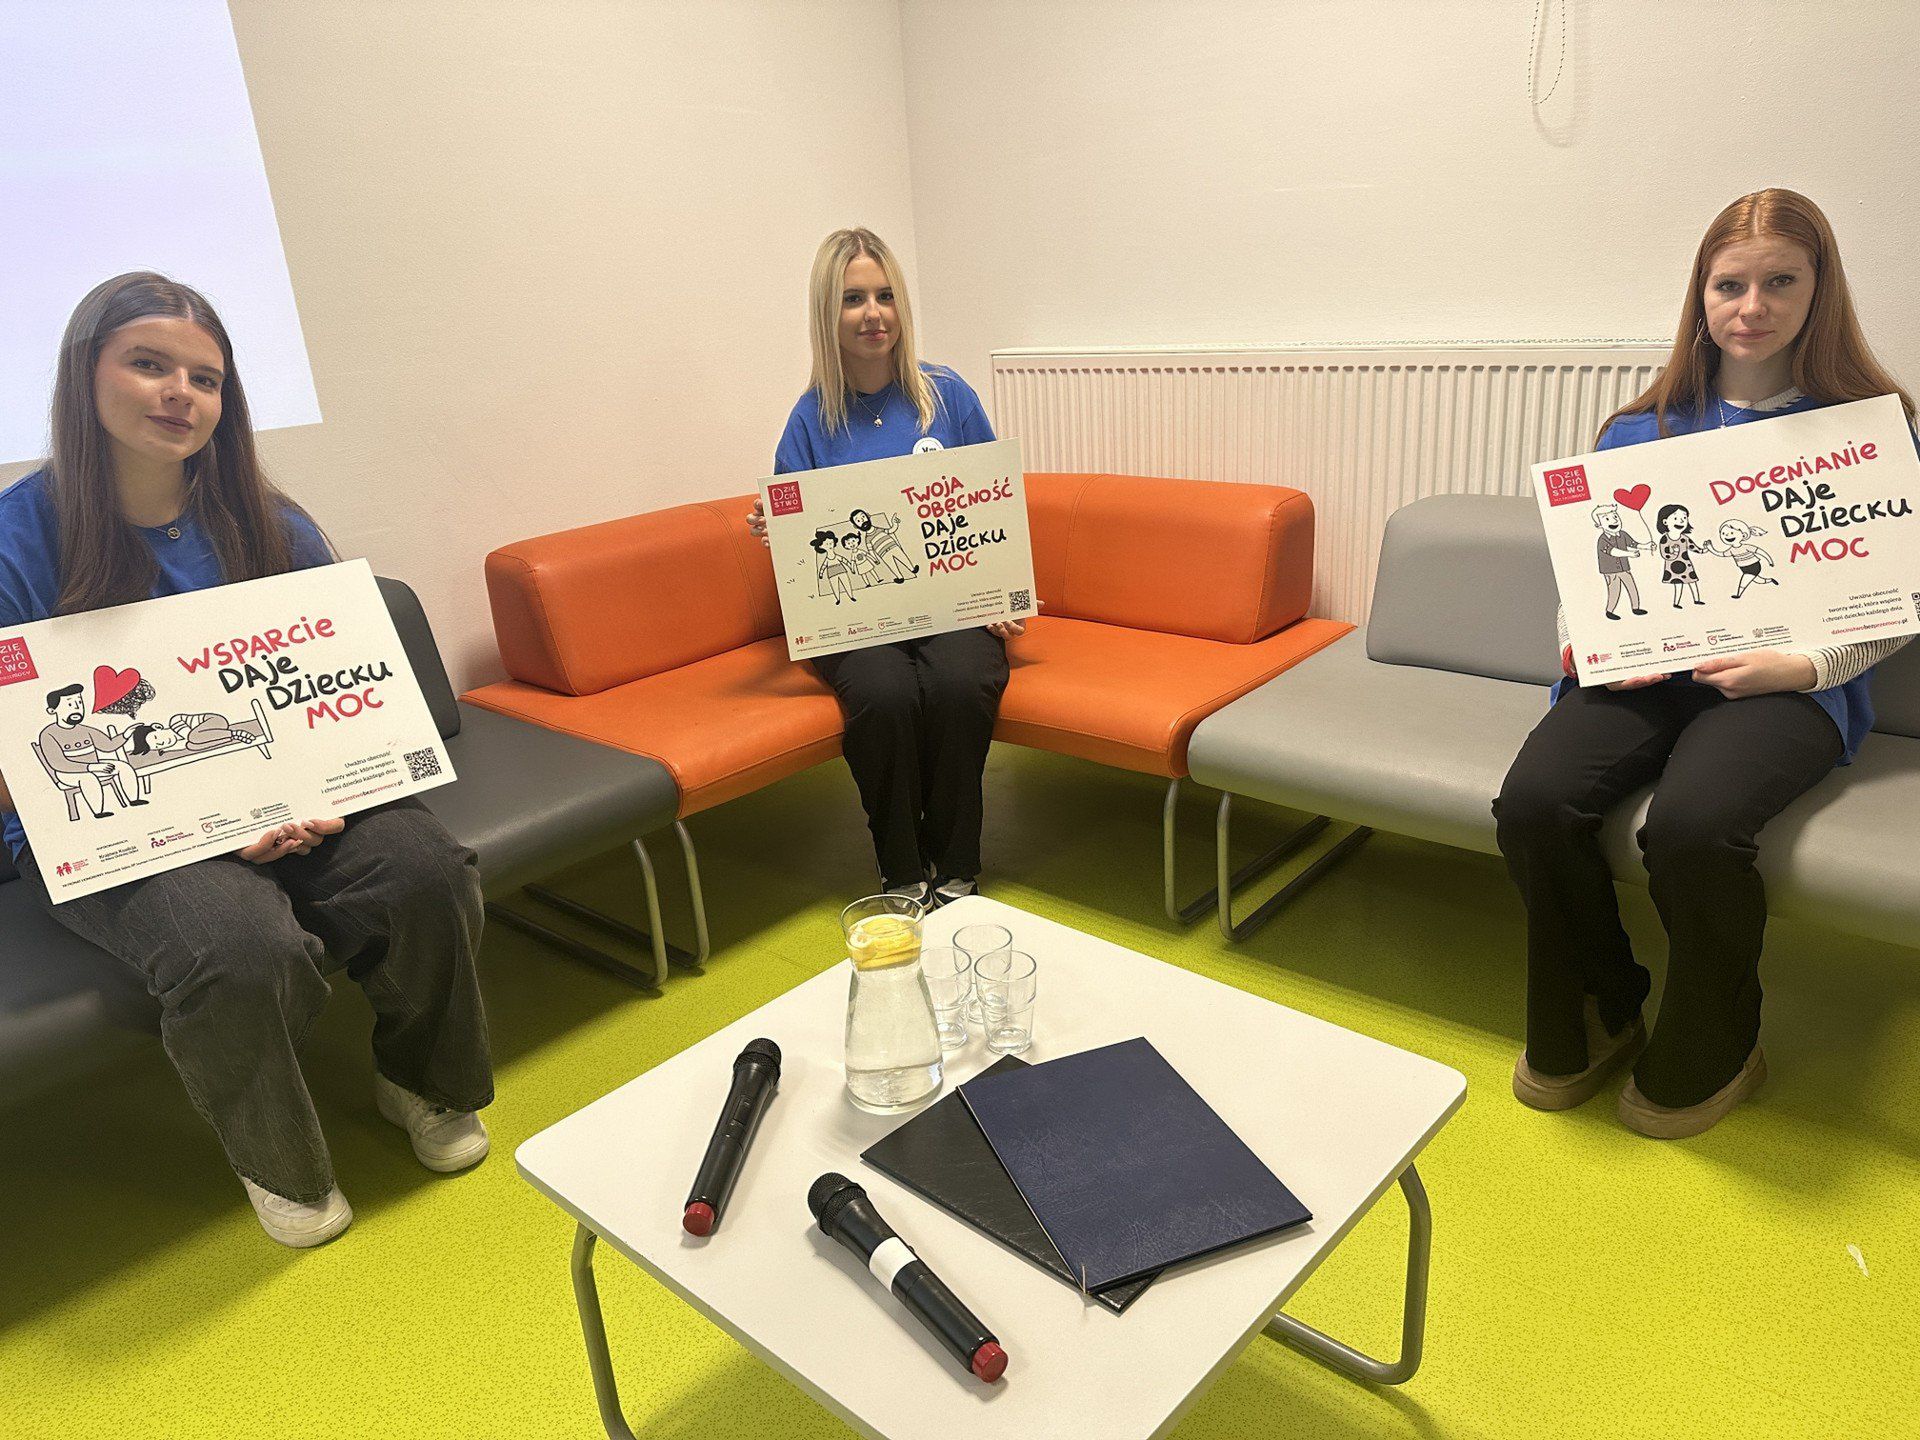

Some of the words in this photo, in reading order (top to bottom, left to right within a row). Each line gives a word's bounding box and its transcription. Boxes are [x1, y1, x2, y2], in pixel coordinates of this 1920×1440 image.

[1790, 537, 1870, 564] MOC
[929, 551, 978, 577] MOC
[1844, 611, 1866, 619] dziecko
[306, 687, 384, 729] MOC
